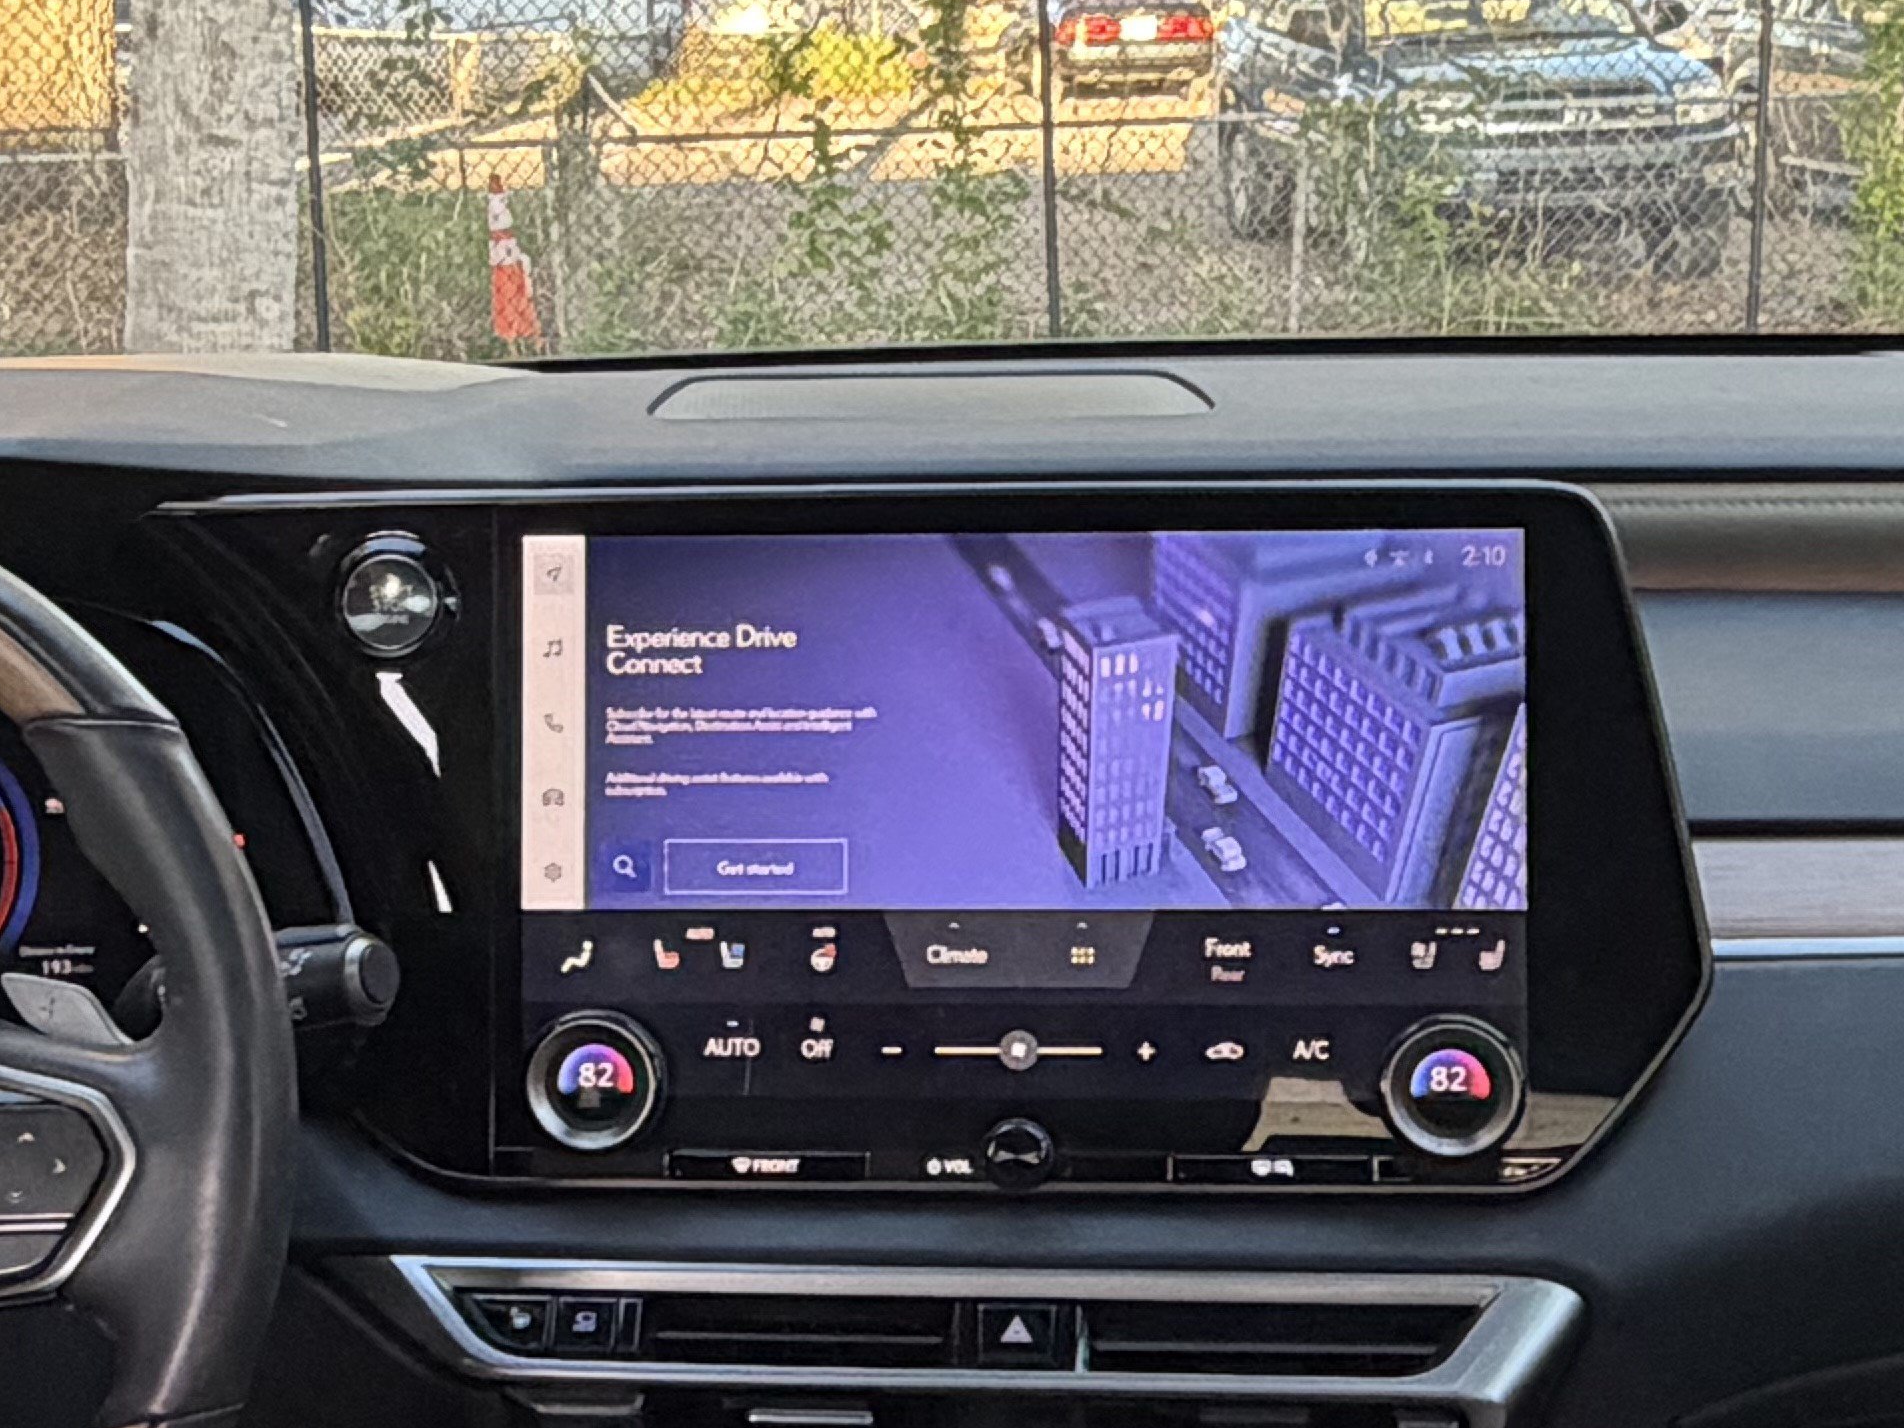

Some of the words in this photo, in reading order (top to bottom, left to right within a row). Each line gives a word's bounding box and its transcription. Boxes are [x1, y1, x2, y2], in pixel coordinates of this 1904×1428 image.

[1461, 544, 1507, 568] 2:10
[605, 623, 731, 652] Experience
[735, 623, 798, 648] Drive
[605, 651, 704, 674] Connect
[716, 859, 745, 876] Get
[927, 943, 989, 965] Climate
[1204, 936, 1253, 959] Front
[1312, 944, 1356, 968] Sync
[703, 1037, 762, 1058] AUTO
[800, 1038, 834, 1060] Off
[1292, 1038, 1330, 1061] A/C
[578, 1062, 615, 1088] 82
[1429, 1066, 1469, 1093] 82
